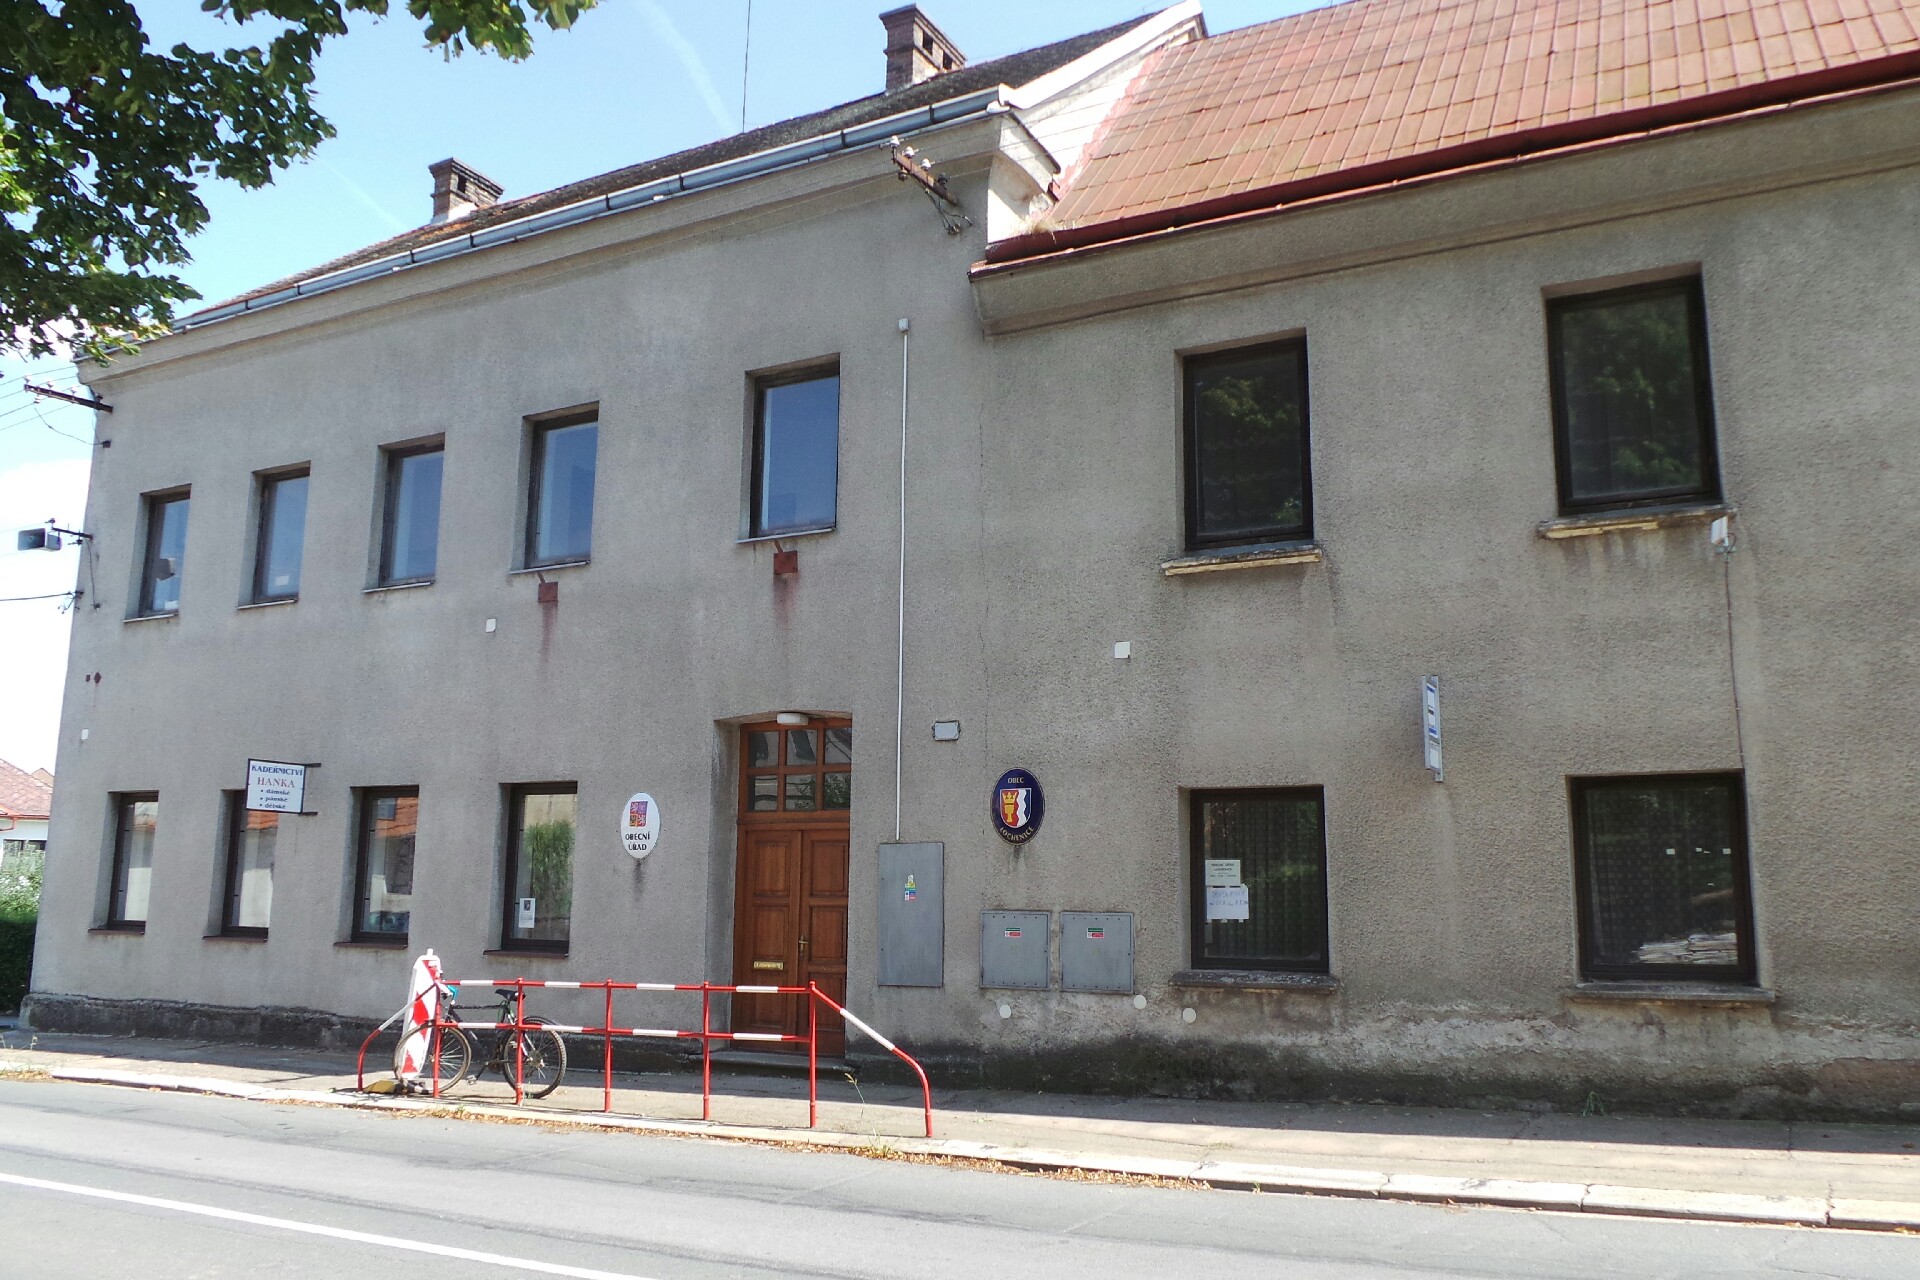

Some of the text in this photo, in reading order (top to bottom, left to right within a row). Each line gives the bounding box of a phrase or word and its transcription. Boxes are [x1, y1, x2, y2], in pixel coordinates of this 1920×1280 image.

[257, 777, 295, 788] HANKA
[625, 831, 651, 841] OBECNÍ
[628, 842, 647, 851] ÚŘAD
